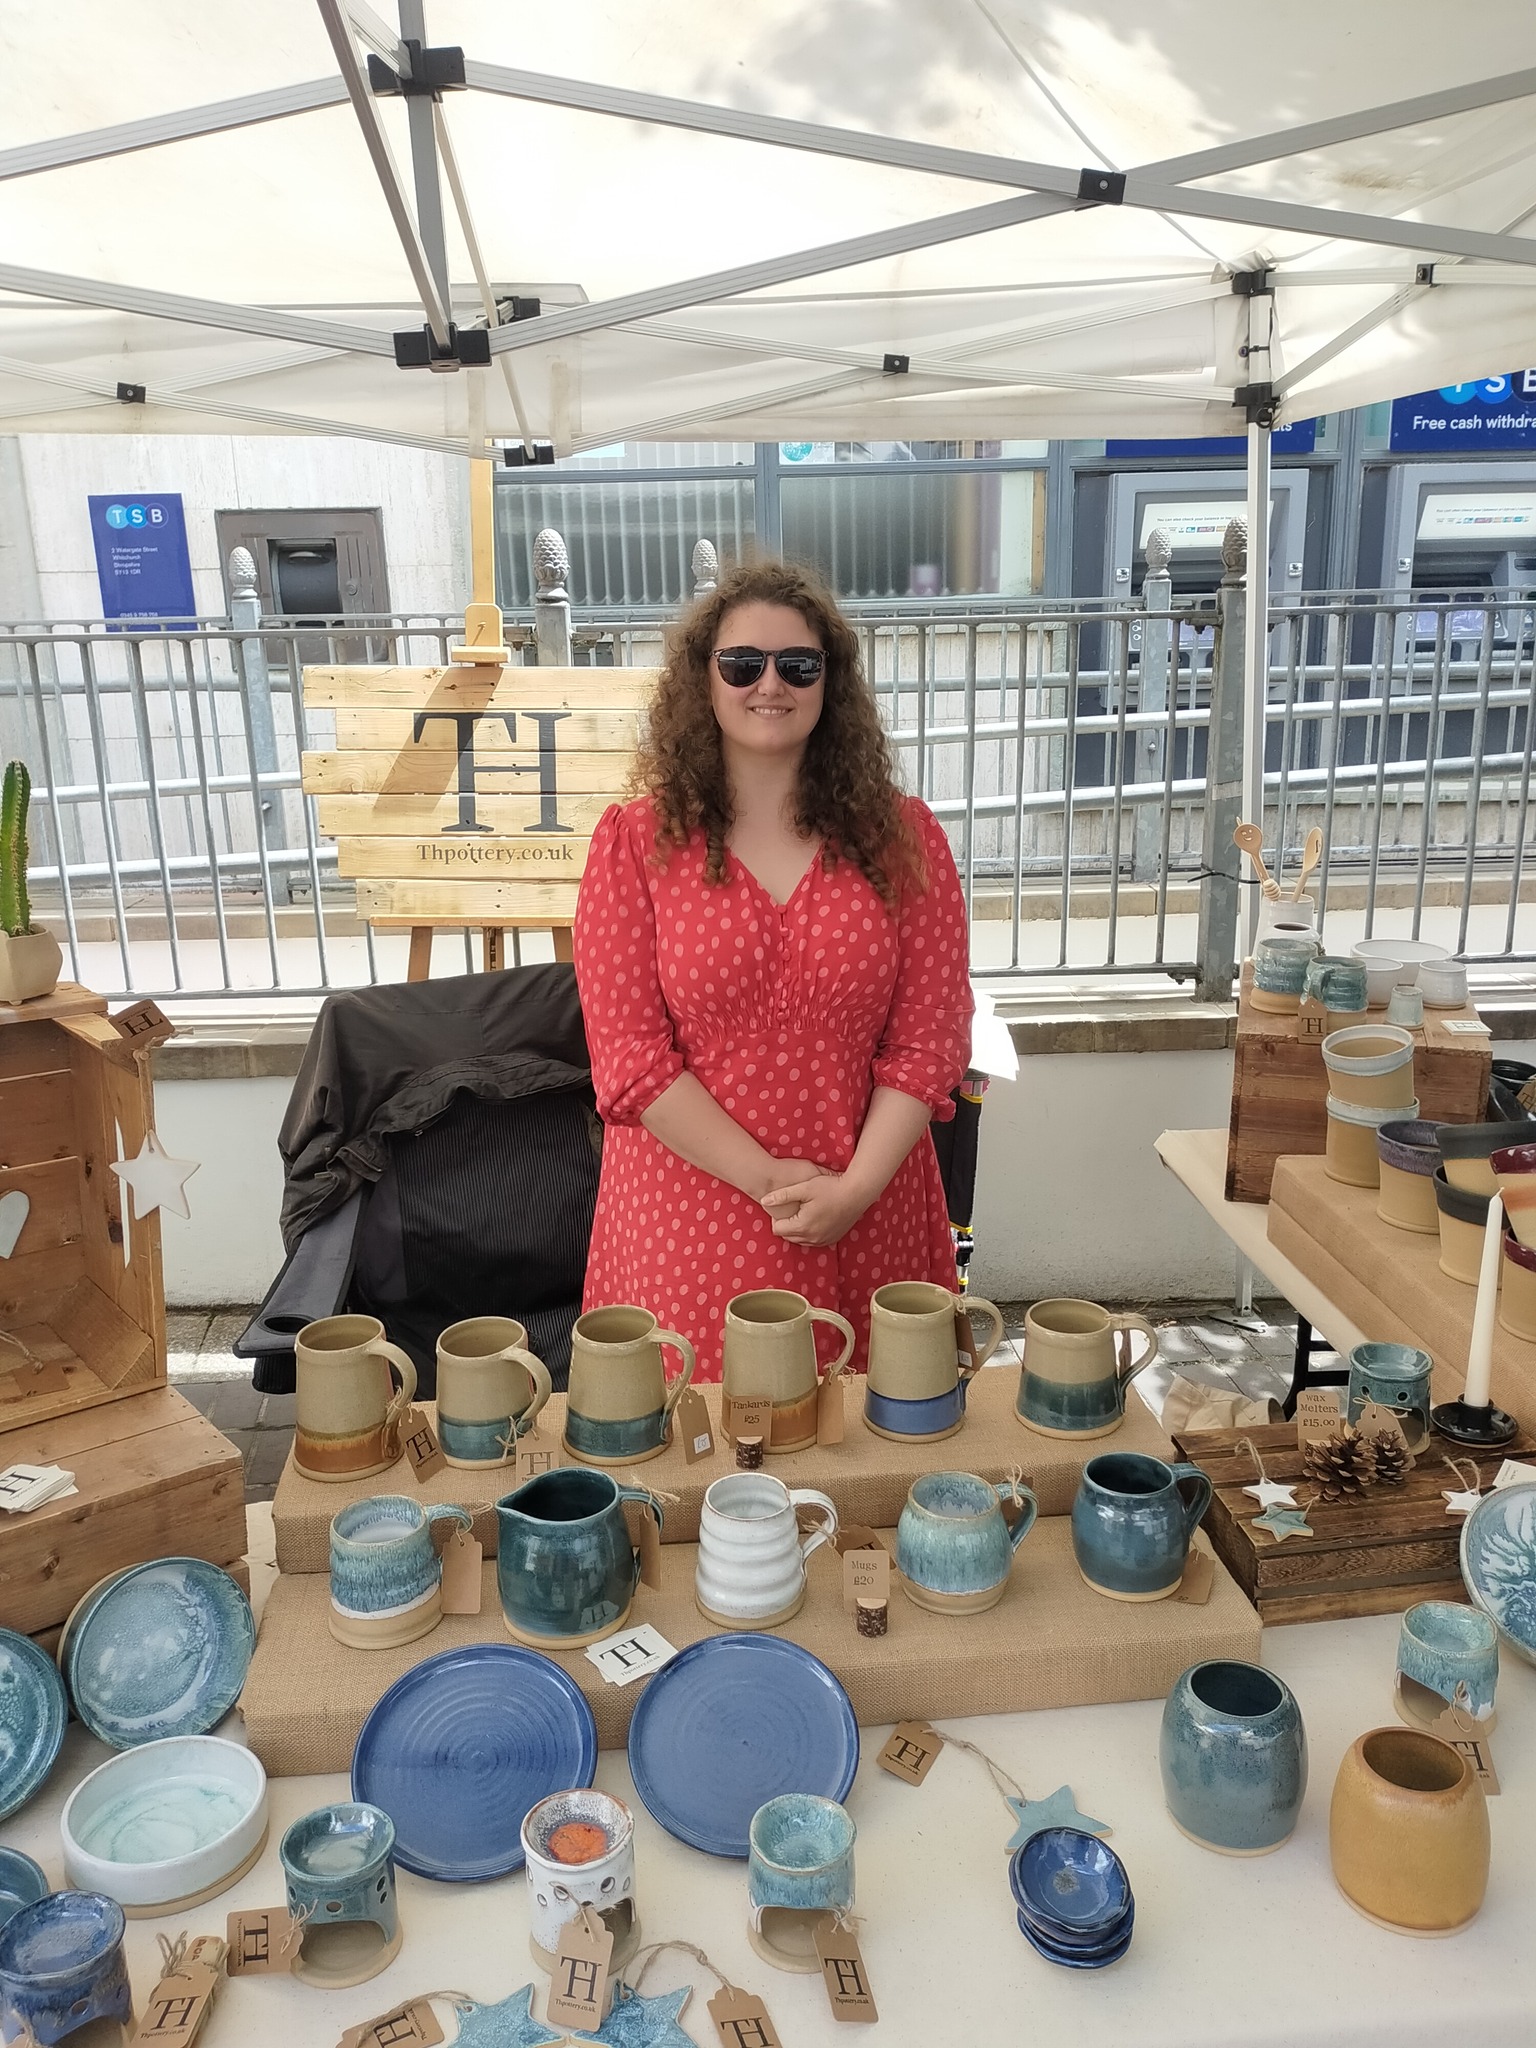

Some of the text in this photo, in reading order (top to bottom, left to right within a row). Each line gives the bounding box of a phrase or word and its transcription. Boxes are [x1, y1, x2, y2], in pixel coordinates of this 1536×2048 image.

[1413, 415, 1447, 430] Free
[1450, 414, 1482, 430] cash
[112, 508, 163, 524] TSB
[413, 712, 574, 832] TH
[417, 844, 574, 864] Thpottery.co.uk
[121, 1011, 163, 1038] TH
[1301, 1017, 1324, 1033] TH
[732, 1401, 771, 1409] Tankards
[1300, 1404, 1339, 1413] Melters
[744, 1415, 760, 1424] £25
[1303, 1418, 1336, 1427] £15.00
[406, 1427, 436, 1462] TH
[521, 1451, 554, 1475] TH
[852, 1561, 878, 1571] Mugs
[853, 1576, 874, 1585] £20
[598, 1637, 656, 1670] TH
[895, 1735, 931, 1771] TH
[243, 1915, 269, 1967] TH
[560, 1956, 602, 2003] TH
[824, 1958, 867, 1996] TH
[150, 1996, 201, 2030] TH
[720, 2016, 774, 2048] TH
